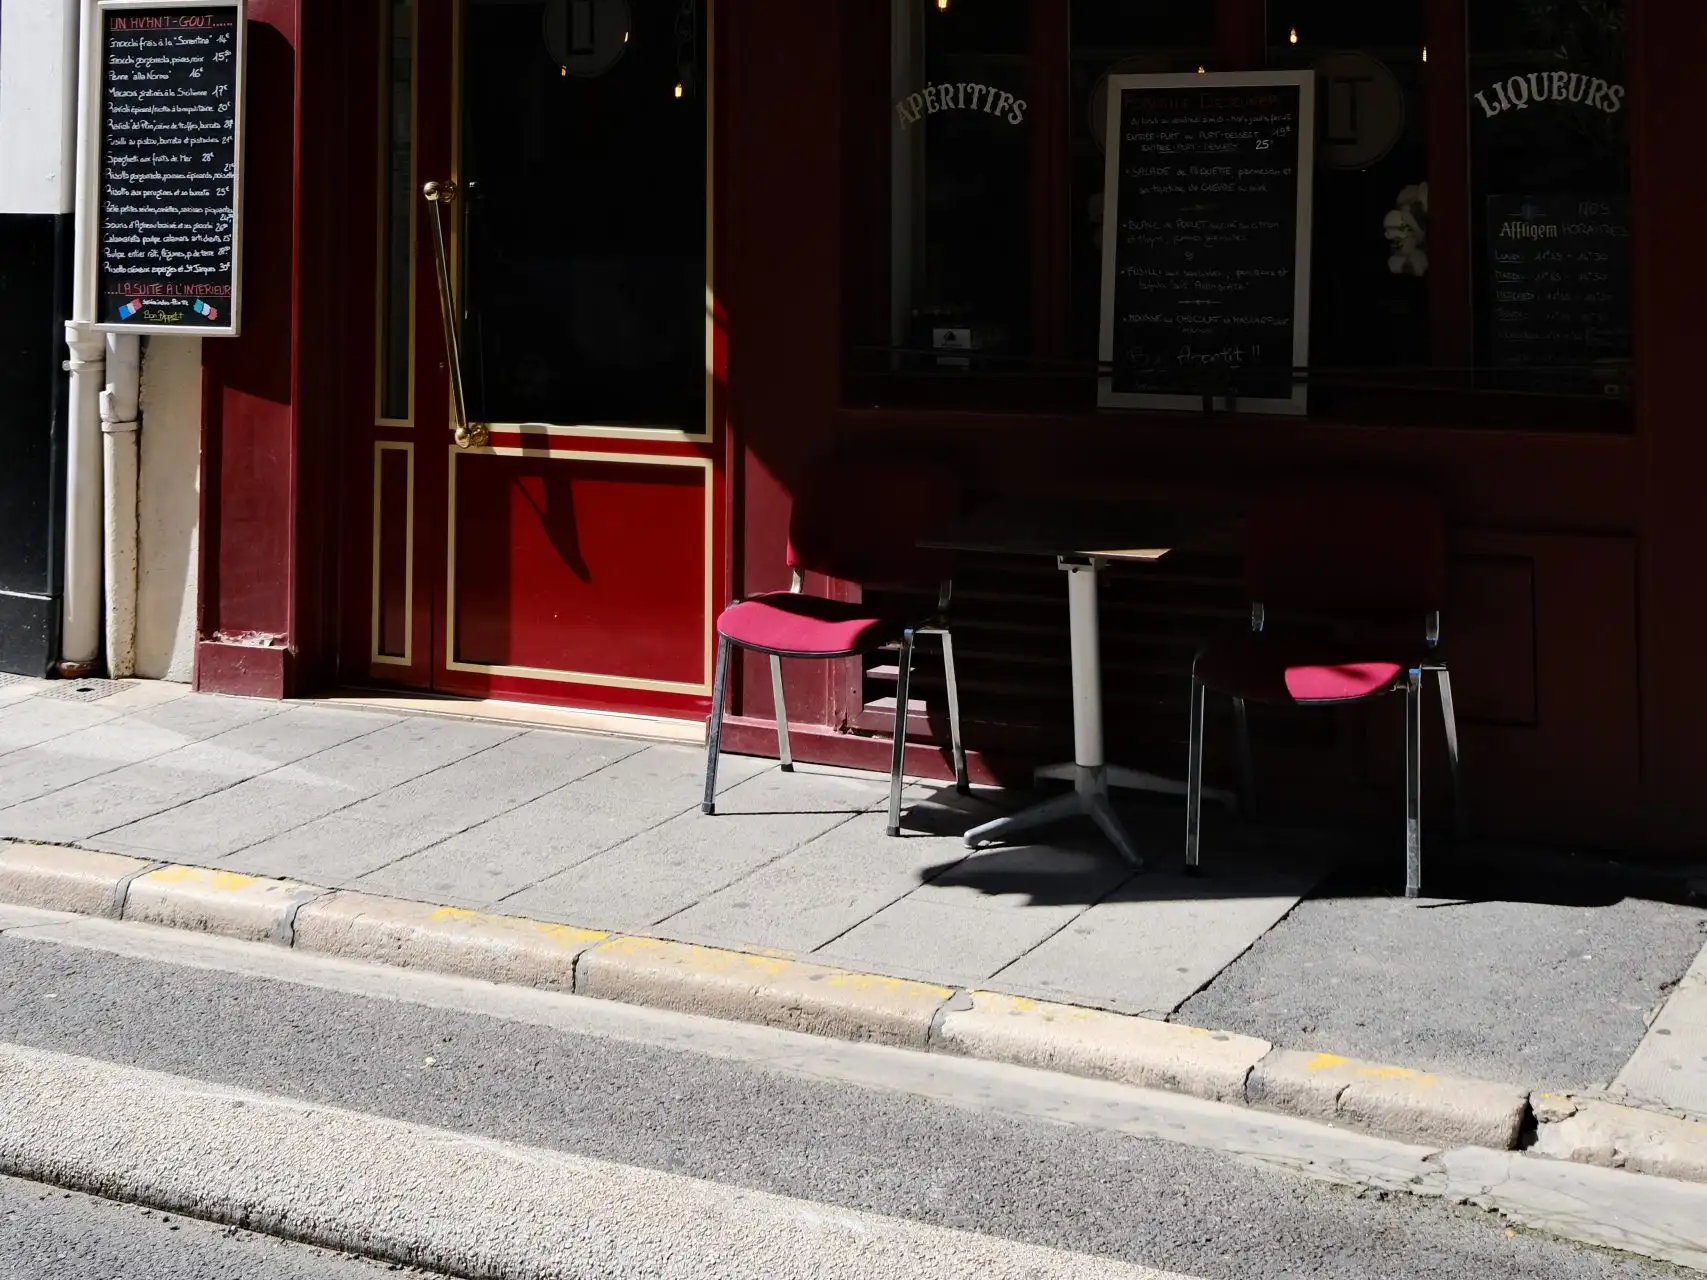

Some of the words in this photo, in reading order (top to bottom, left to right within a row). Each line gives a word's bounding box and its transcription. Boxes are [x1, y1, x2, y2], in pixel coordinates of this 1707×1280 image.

[140, 37, 157, 50] frais
[165, 38, 173, 46] la
[895, 81, 1027, 130] APÉRITIFS
[1474, 71, 1625, 118] LIQUEURS
[1498, 221, 1558, 240] Affligem
